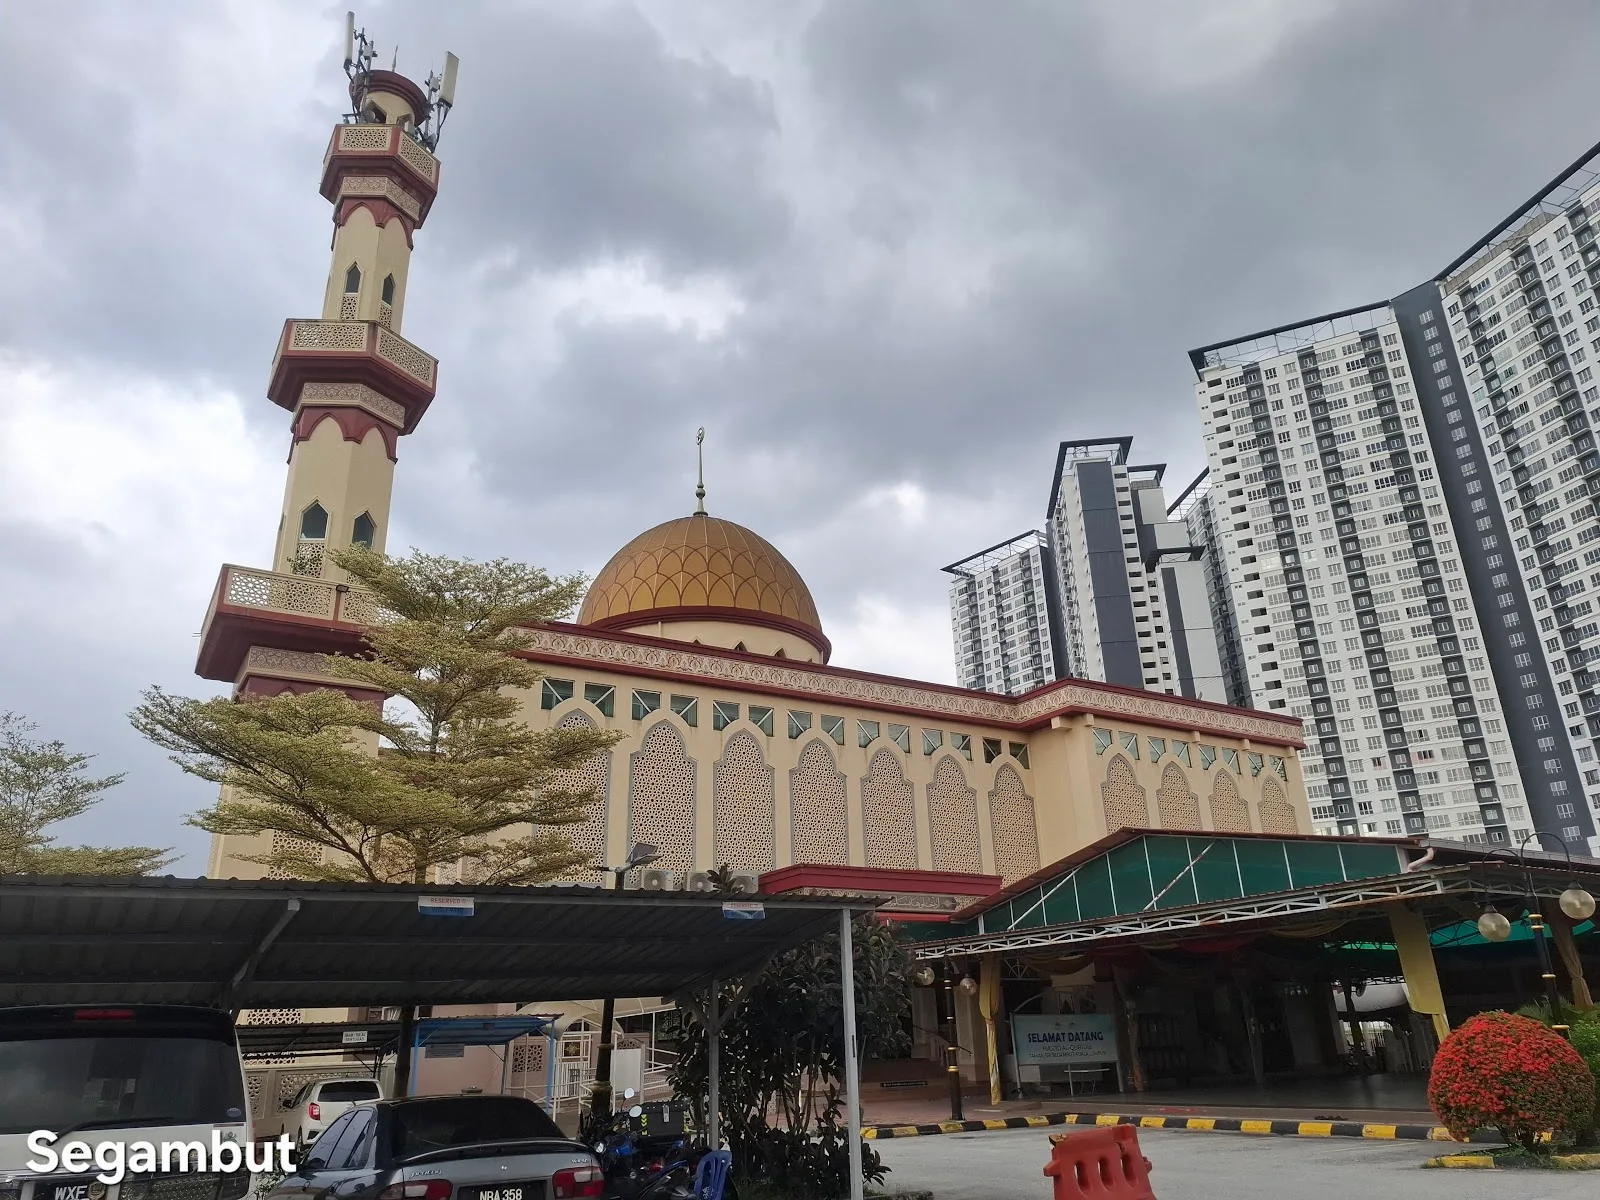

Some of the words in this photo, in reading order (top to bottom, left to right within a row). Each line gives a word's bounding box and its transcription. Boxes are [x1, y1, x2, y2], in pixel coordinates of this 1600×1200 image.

[1028, 1032, 1066, 1043] SELAMAT
[1068, 1031, 1104, 1042] DATANG
[502, 1188, 523, 1200] 358
